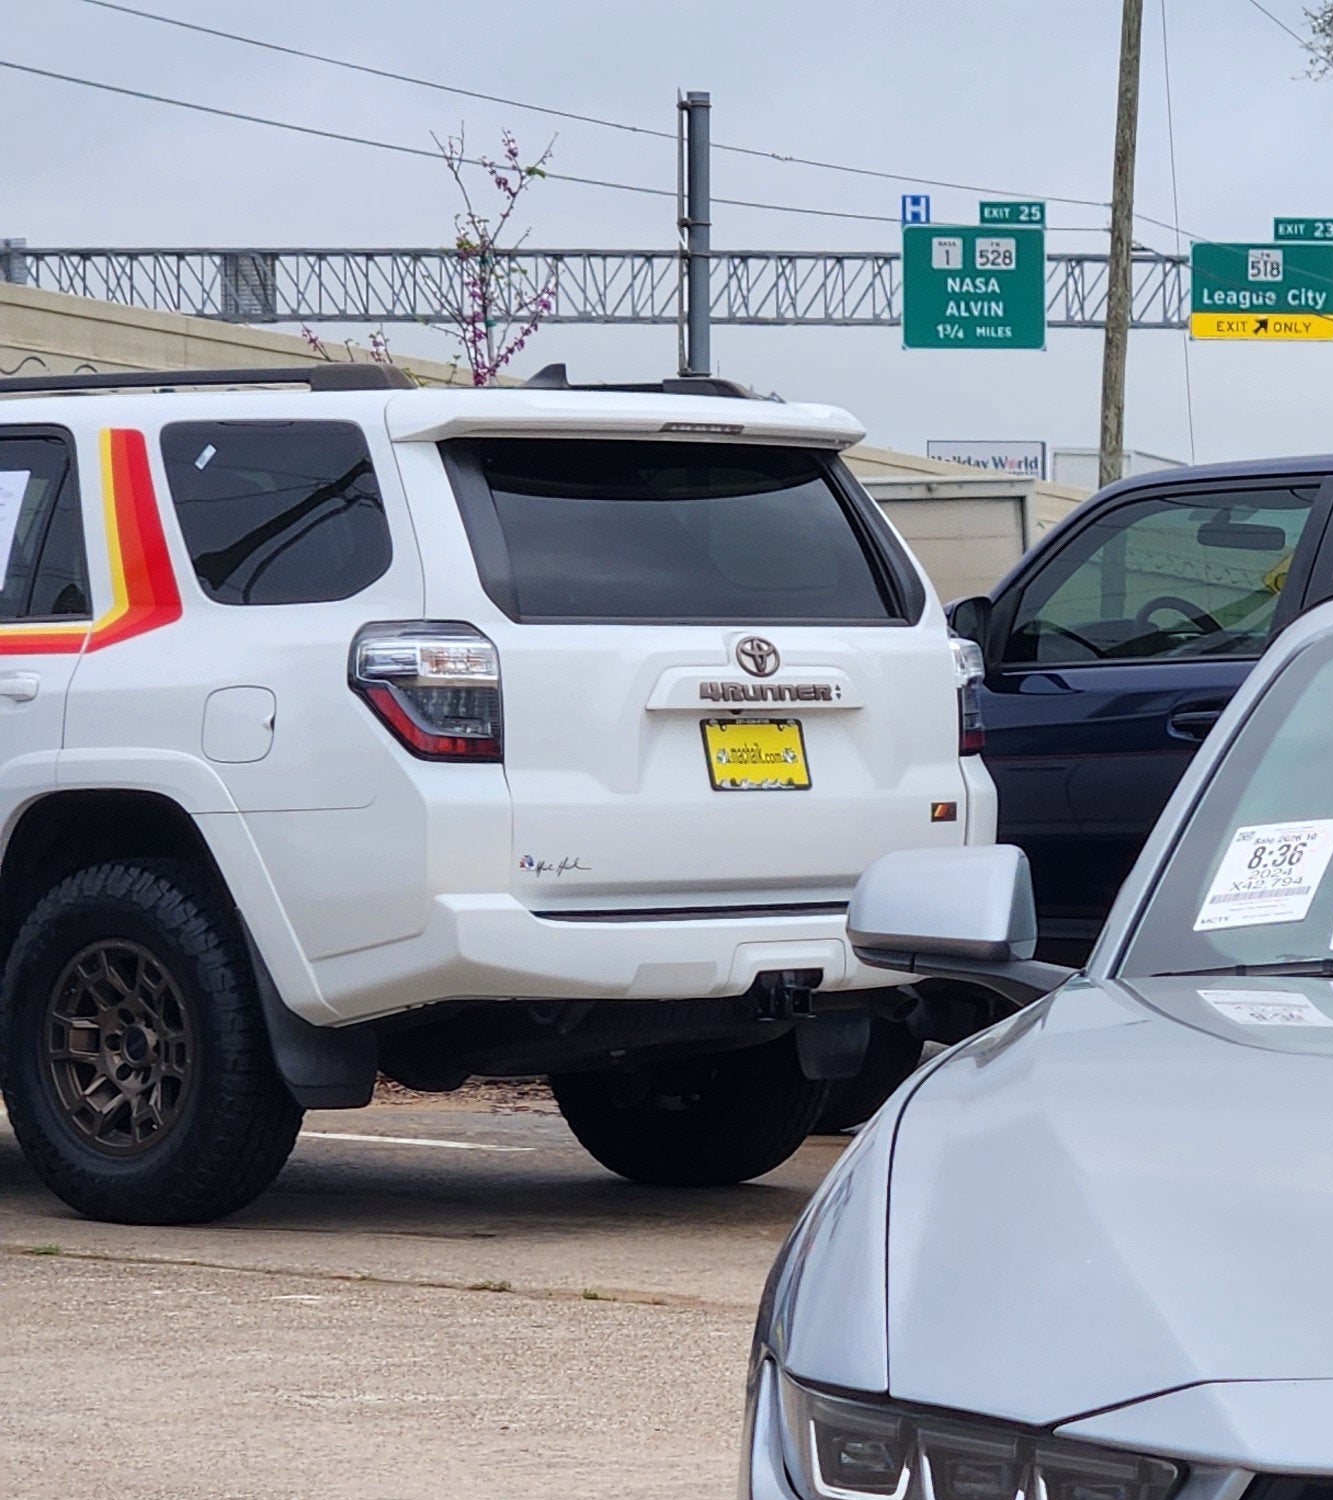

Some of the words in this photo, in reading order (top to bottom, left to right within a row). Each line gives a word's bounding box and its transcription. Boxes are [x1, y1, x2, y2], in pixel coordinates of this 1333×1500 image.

[983, 207, 1011, 219] EXIT
[1019, 206, 1042, 221] 25
[1278, 223, 1306, 236] EXIT
[945, 250, 950, 266] 1
[978, 250, 1013, 267] 528
[1250, 261, 1281, 278] 518
[946, 277, 1001, 294] NASA
[1202, 287, 1277, 308] League
[1287, 286, 1327, 309] City
[945, 300, 1004, 317] ALVIN
[975, 326, 1012, 338] MILES
[1216, 320, 1248, 333] EXIT
[1273, 321, 1312, 334] ONLY
[991, 455, 1039, 470] World
[1247, 843, 1308, 869] 8:36
[1248, 867, 1293, 880] 2024
